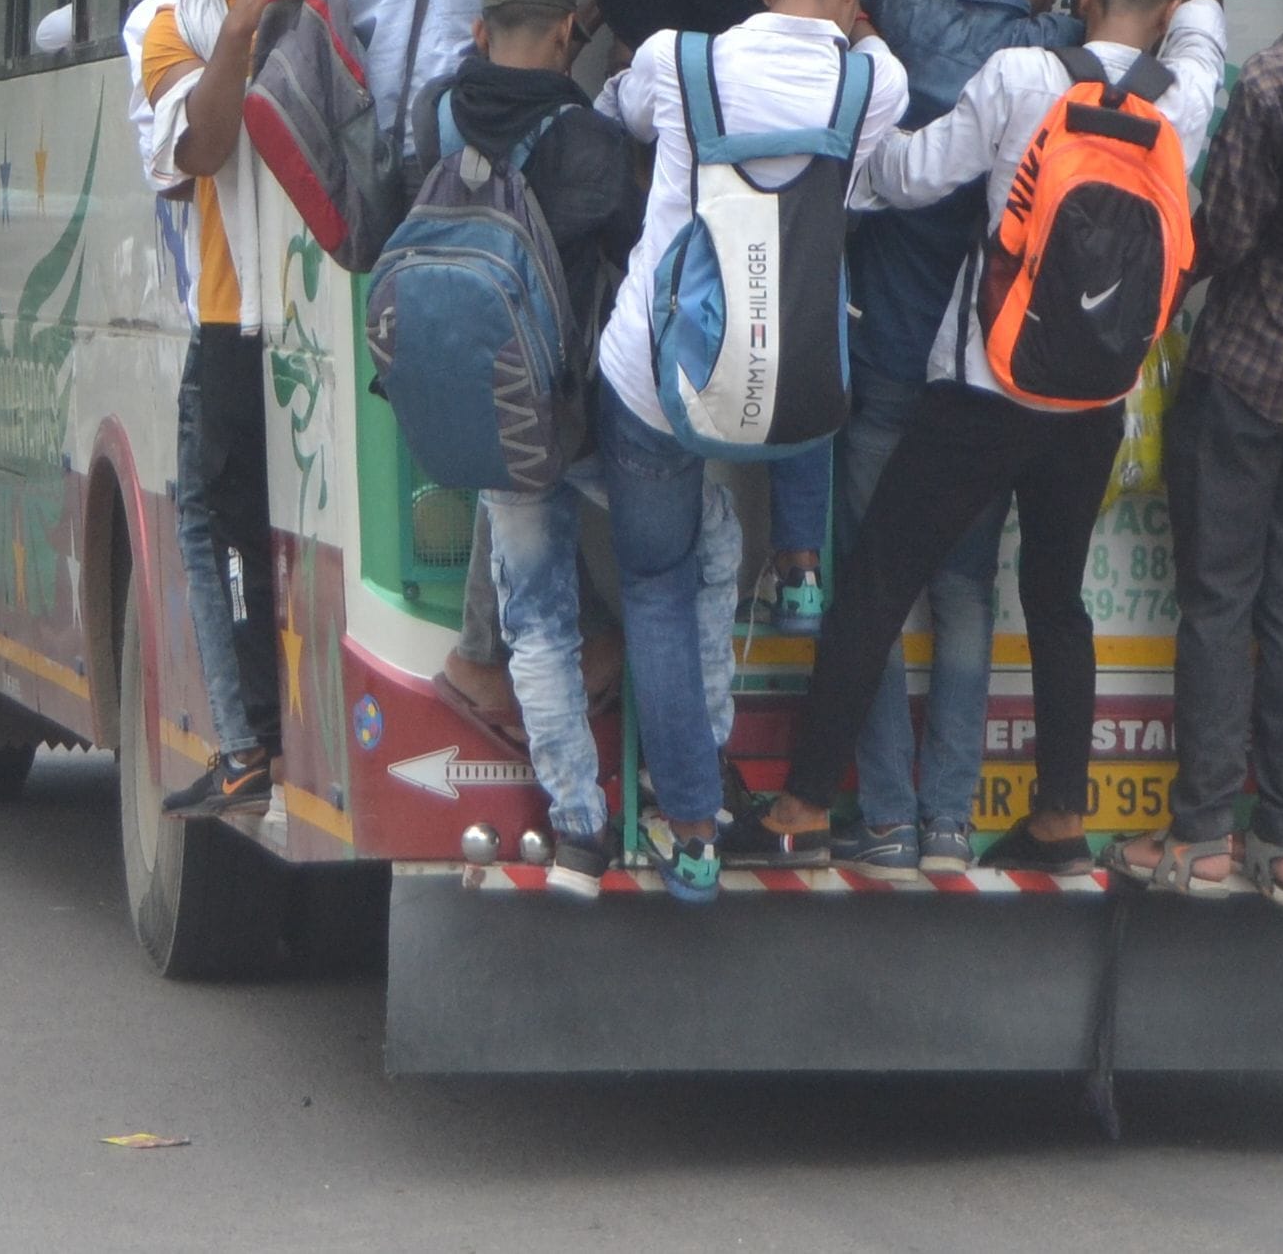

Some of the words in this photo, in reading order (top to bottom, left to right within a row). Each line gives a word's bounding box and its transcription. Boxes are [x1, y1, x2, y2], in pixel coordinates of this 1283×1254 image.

[748, 242, 767, 320] HILFIGER
[740, 353, 766, 428] TOMMY
[1091, 719, 1176, 751] STA
